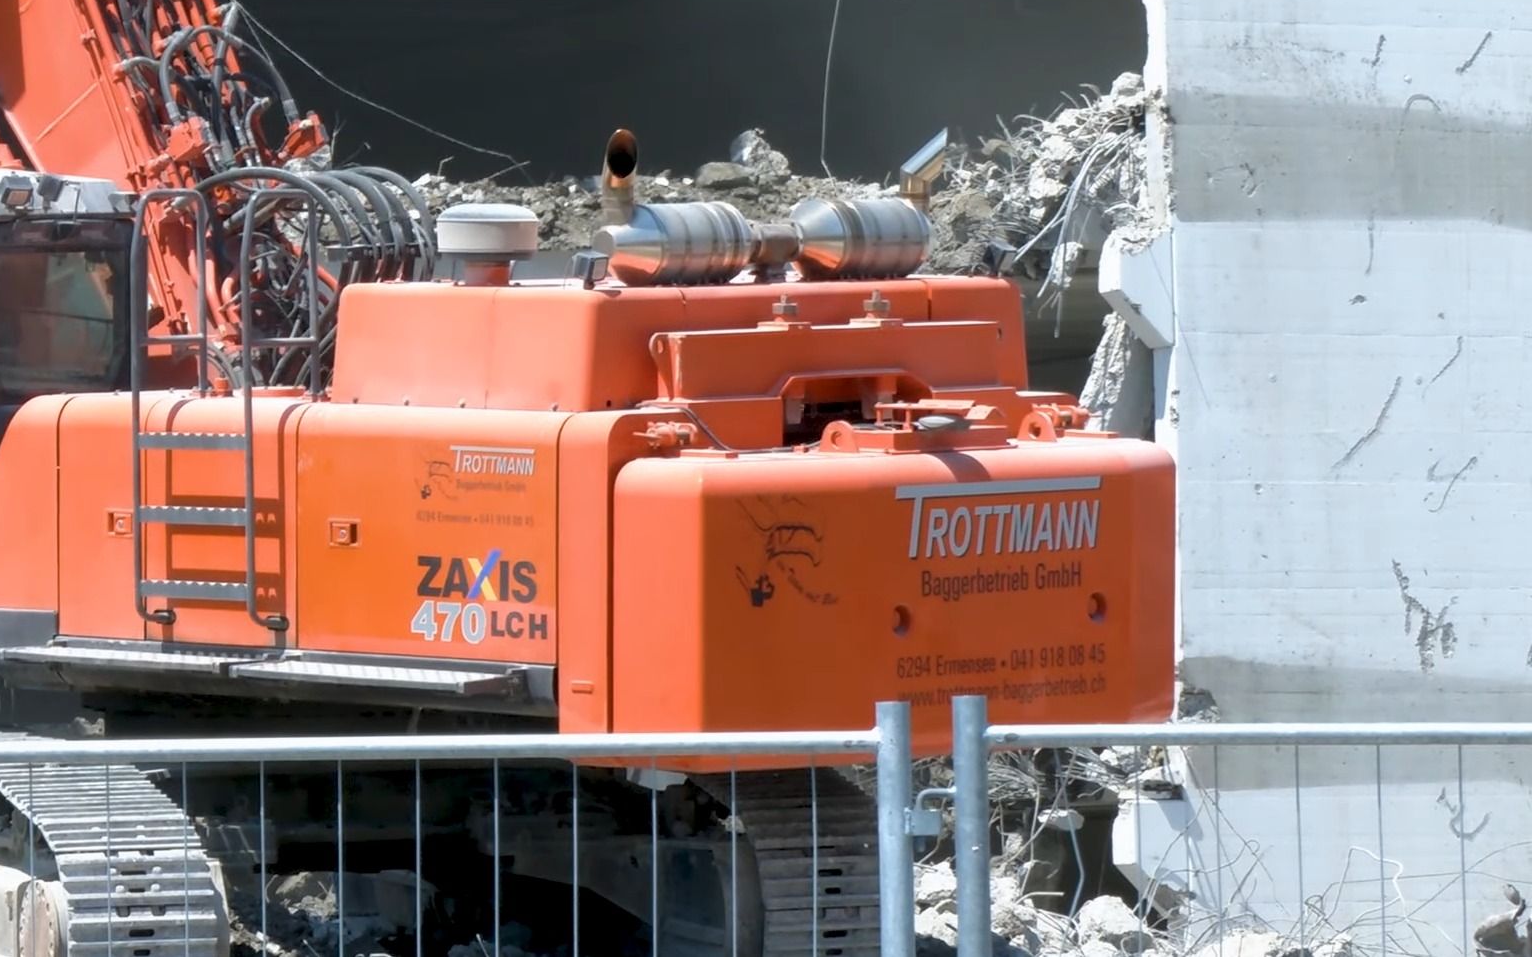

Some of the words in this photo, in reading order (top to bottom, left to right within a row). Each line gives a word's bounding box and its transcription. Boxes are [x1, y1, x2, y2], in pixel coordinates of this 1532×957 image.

[450, 445, 536, 476] TROTTMANN
[895, 476, 1101, 559] TROTTMANN
[417, 548, 537, 604] ZAXIS
[921, 564, 1029, 601] Baggerbetrieb
[1035, 561, 1082, 589] GmbH
[411, 599, 487, 645] 470
[490, 610, 548, 640] LCH
[897, 654, 931, 679] 6294
[936, 654, 996, 676] Ermensee
[1011, 648, 1034, 671] 041
[1040, 646, 1064, 668] 918
[1069, 643, 1085, 667] 08
[1089, 642, 1106, 664] 45
